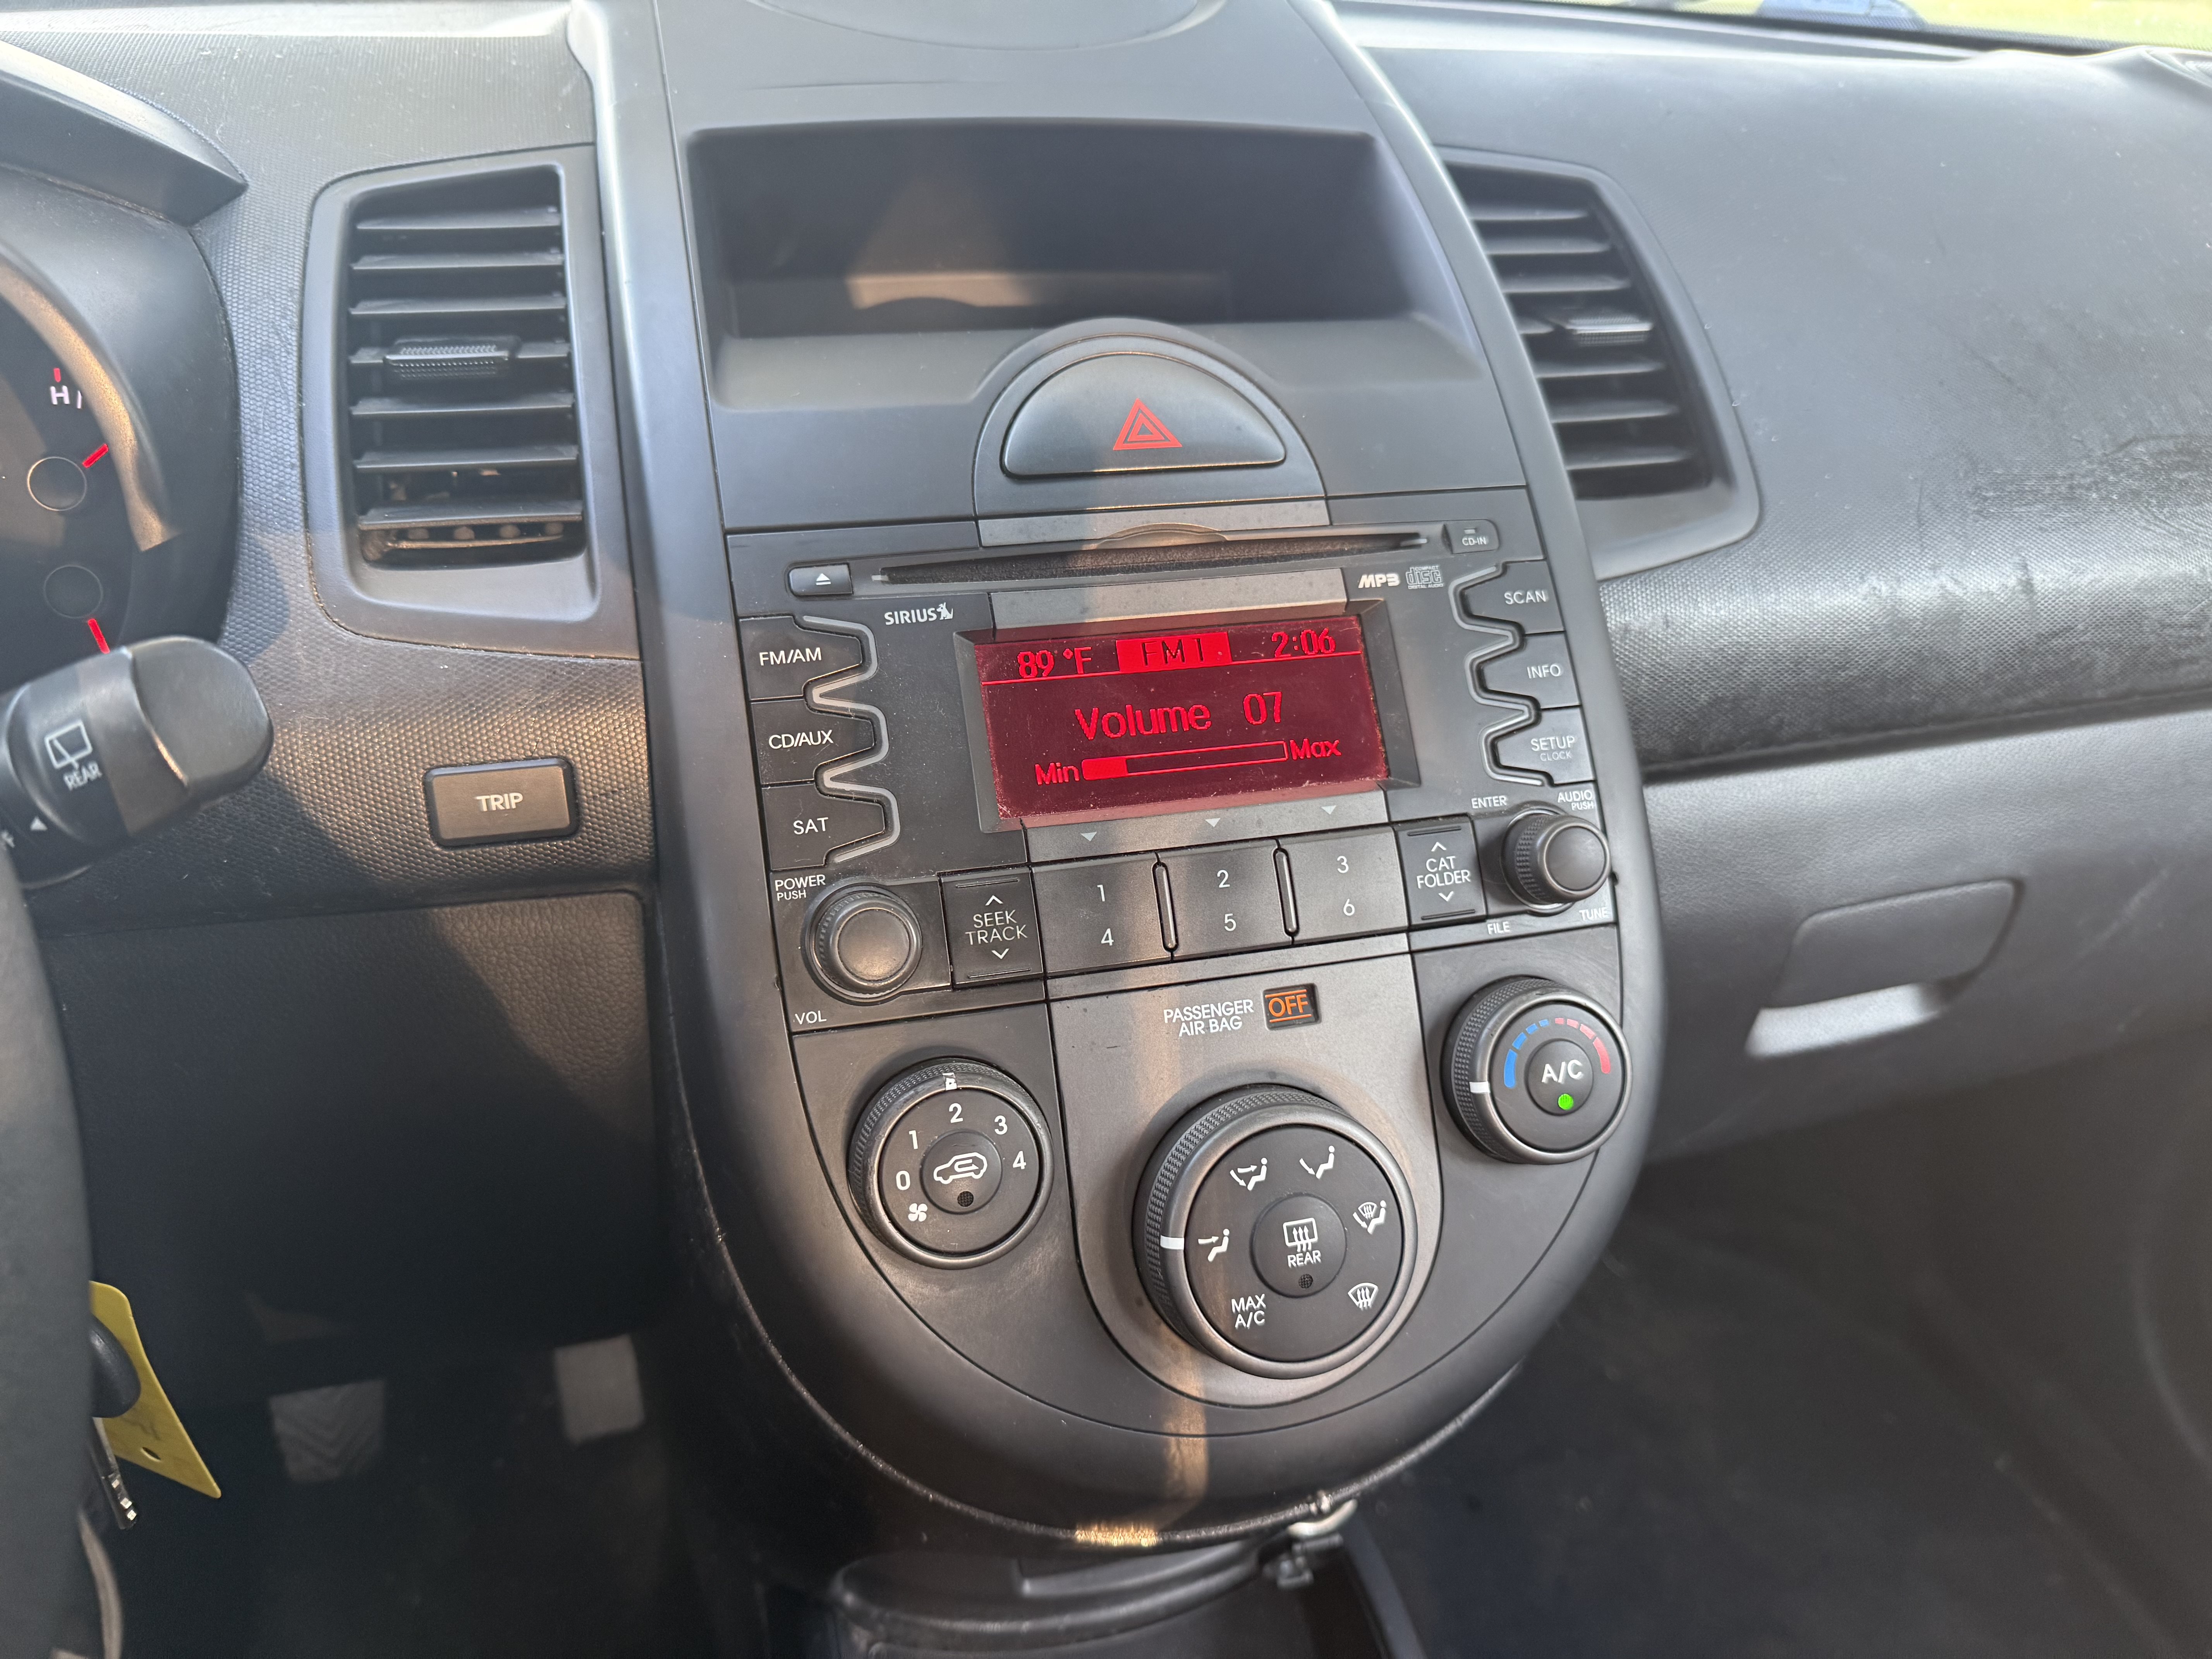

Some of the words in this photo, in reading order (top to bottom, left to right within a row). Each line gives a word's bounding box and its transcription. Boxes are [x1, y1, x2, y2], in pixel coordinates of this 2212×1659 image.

[1462, 537, 1487, 546] CD-IN
[1358, 573, 1400, 588] MP3
[1504, 590, 1547, 605] SCAN
[884, 608, 936, 625] SIRIUS
[759, 647, 821, 666] FM/AM
[1017, 650, 1054, 678] 89
[1271, 628, 1336, 657] 2:06
[1527, 664, 1561, 678] INFO
[1074, 703, 1211, 740] Volume
[1242, 691, 1283, 725] 07
[769, 730, 833, 749] CD/AUX
[1530, 736, 1575, 751] SETUP
[1034, 762, 1080, 785] Min
[1289, 738, 1342, 760] Max
[1540, 750, 1572, 761] CLOCK
[63, 761, 103, 791] REAR
[476, 792, 523, 812] TRIP
[1471, 795, 1507, 809] ENTER
[1557, 790, 1593, 803] AUDIO
[1571, 801, 1594, 811] PUSH
[793, 817, 828, 835] SAT
[1337, 856, 1349, 873] 3
[1426, 855, 1455, 872] CAT
[775, 874, 826, 891] POWER
[1217, 869, 1230, 888] 2
[1417, 870, 1470, 889] FOLDER
[777, 890, 807, 902] PUSH
[1097, 884, 1106, 902] 1
[1343, 899, 1355, 916] 6
[1579, 907, 1608, 921] TUNE
[973, 909, 1017, 929] SEEK
[1224, 913, 1237, 932] 5
[1487, 921, 1510, 935] FILE
[965, 924, 1028, 945] TRACK
[1101, 928, 1114, 946] 4
[1163, 999, 1254, 1024] PASSENGER
[1267, 994, 1309, 1017] OFF
[795, 1010, 827, 1025] VOL
[1178, 1020, 1206, 1037] AIR
[1209, 1016, 1243, 1033] BAG
[1541, 1059, 1583, 1084] A/C
[949, 1103, 963, 1123] 2
[994, 1116, 1008, 1135] 3
[909, 1130, 918, 1149] 1
[1013, 1151, 1027, 1170] 4
[896, 1170, 911, 1190] 0
[1287, 1250, 1321, 1268] REAR
[1231, 1294, 1266, 1313] MAX
[1235, 1310, 1265, 1329] A/C
